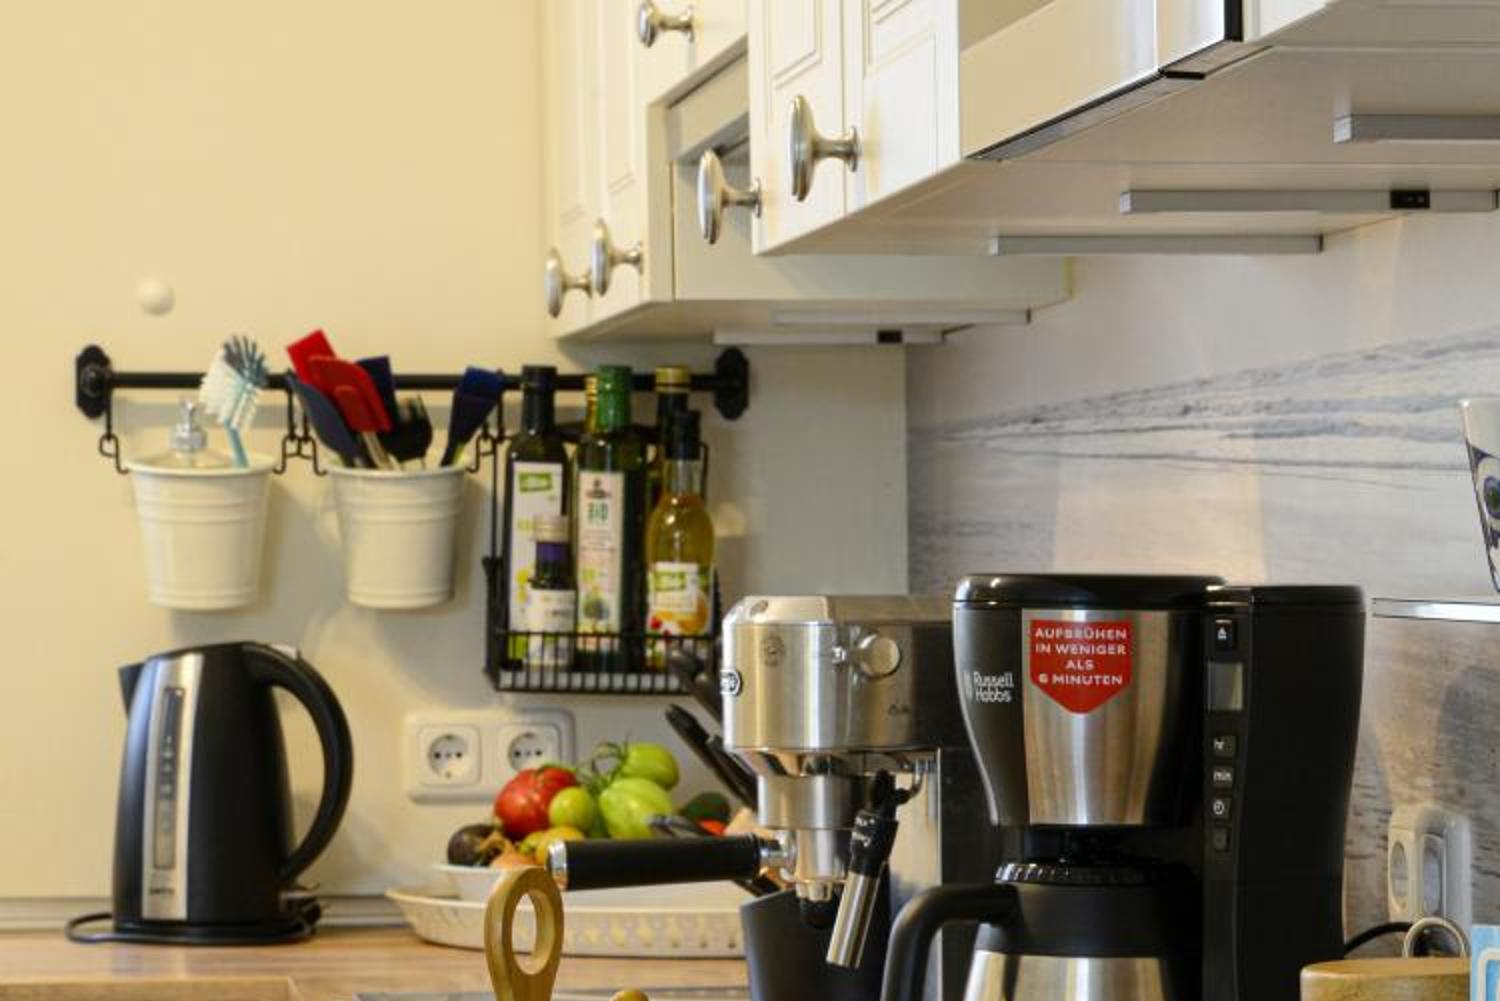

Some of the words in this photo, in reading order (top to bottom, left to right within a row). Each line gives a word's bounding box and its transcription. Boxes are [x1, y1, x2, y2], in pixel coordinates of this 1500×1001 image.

[1034, 627, 1127, 640] AUFBRÜHEN
[1035, 643, 1051, 654] IN
[1055, 643, 1127, 655] WENIGER
[1065, 658, 1094, 671] ALS
[973, 670, 1015, 688] Russell
[1038, 673, 1049, 684] 6
[1052, 673, 1123, 686] MINUTEN
[975, 687, 1012, 703] Hobbs
